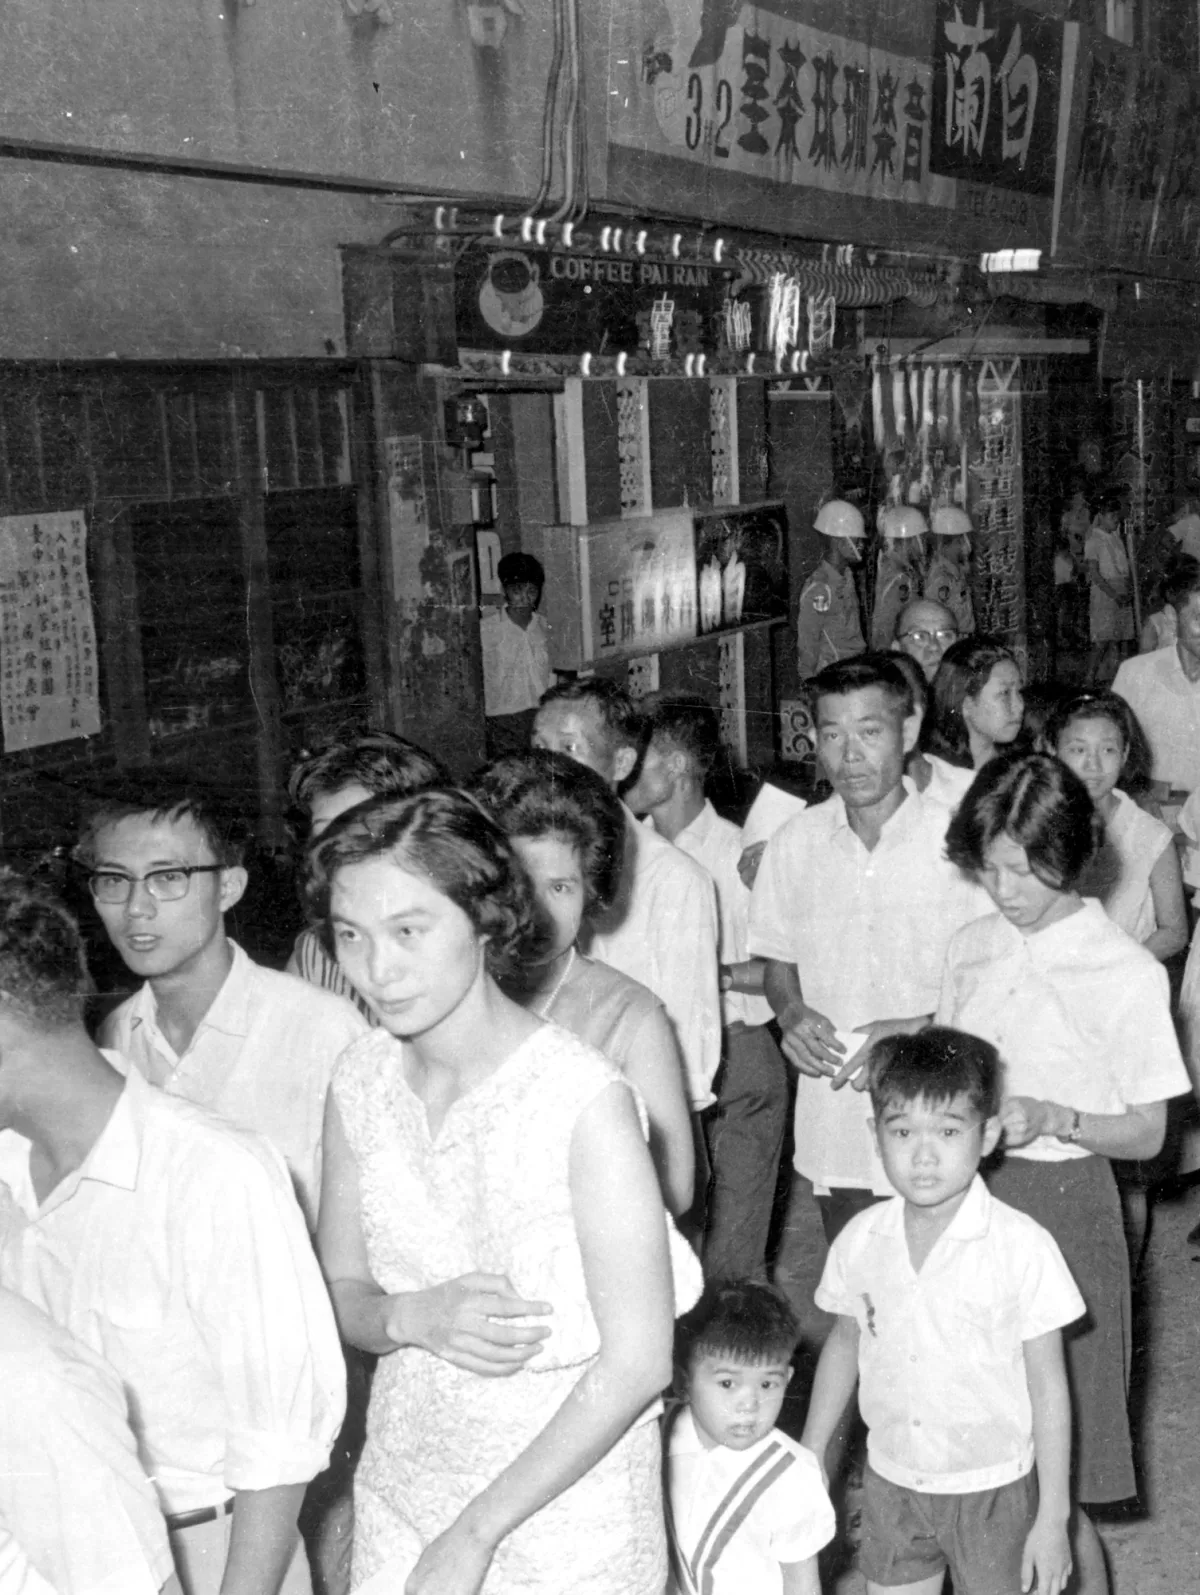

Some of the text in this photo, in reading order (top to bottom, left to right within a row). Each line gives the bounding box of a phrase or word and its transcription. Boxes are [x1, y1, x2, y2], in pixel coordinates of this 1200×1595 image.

[943, 2, 1039, 170] 白蘭
[552, 256, 709, 287] COFFEE PAI RAN
